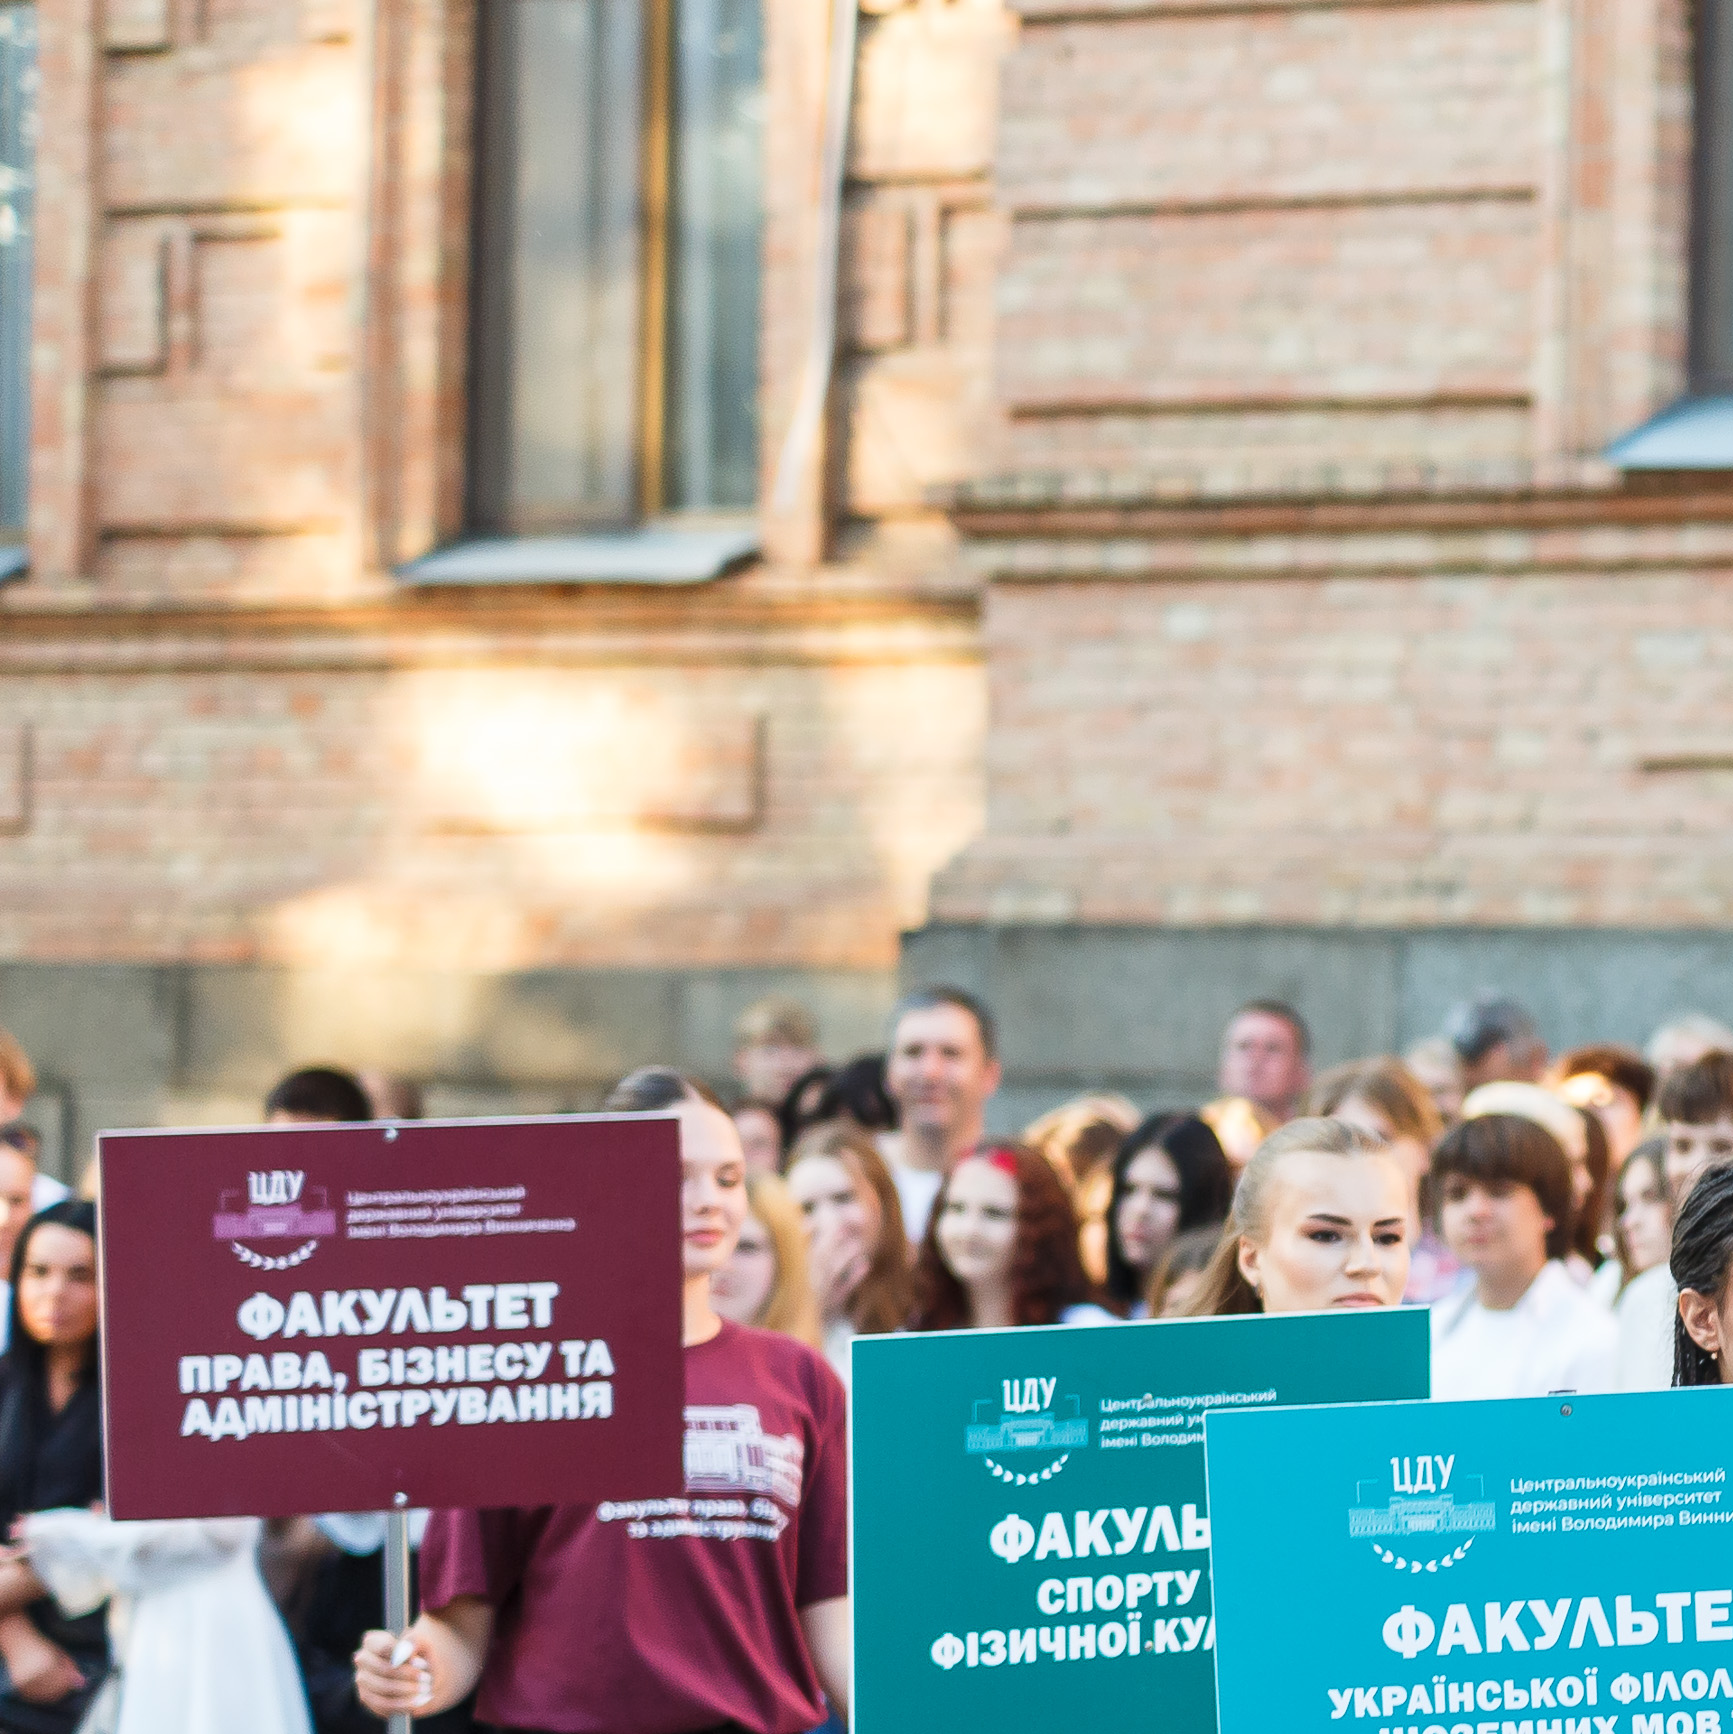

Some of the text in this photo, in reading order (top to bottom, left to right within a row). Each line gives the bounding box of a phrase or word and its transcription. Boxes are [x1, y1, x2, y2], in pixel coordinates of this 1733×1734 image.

[248, 1169, 305, 1205] ЦДУ
[237, 1281, 560, 1341] ФАКУЛЬТЕТ
[178, 1338, 616, 1394] ПРАВА, БІЗНЕСУ ТА
[180, 1381, 614, 1442] АДМІНІСТРУВАННЯ
[1002, 1376, 1056, 1413] ЦДУ
[1100, 1388, 1278, 1413] Центральноукраїнський
[1100, 1414, 1184, 1432] державний
[1100, 1432, 1206, 1448] імені Володим
[1390, 1454, 1456, 1494] ЦДУ
[1510, 1467, 1726, 1495] Центральноукраїнський
[1510, 1489, 1722, 1516] державний університет
[989, 1504, 1211, 1564] ФАКУЛЬ
[1511, 1516, 1557, 1534] імені
[1560, 1512, 1675, 1532] Володимира
[1037, 1569, 1201, 1615] СПОРТУ
[930, 1611, 1142, 1670] ФІЗИЧНОЇ
[1327, 1666, 1600, 1720] УКРАЇНСЬКОЇ
